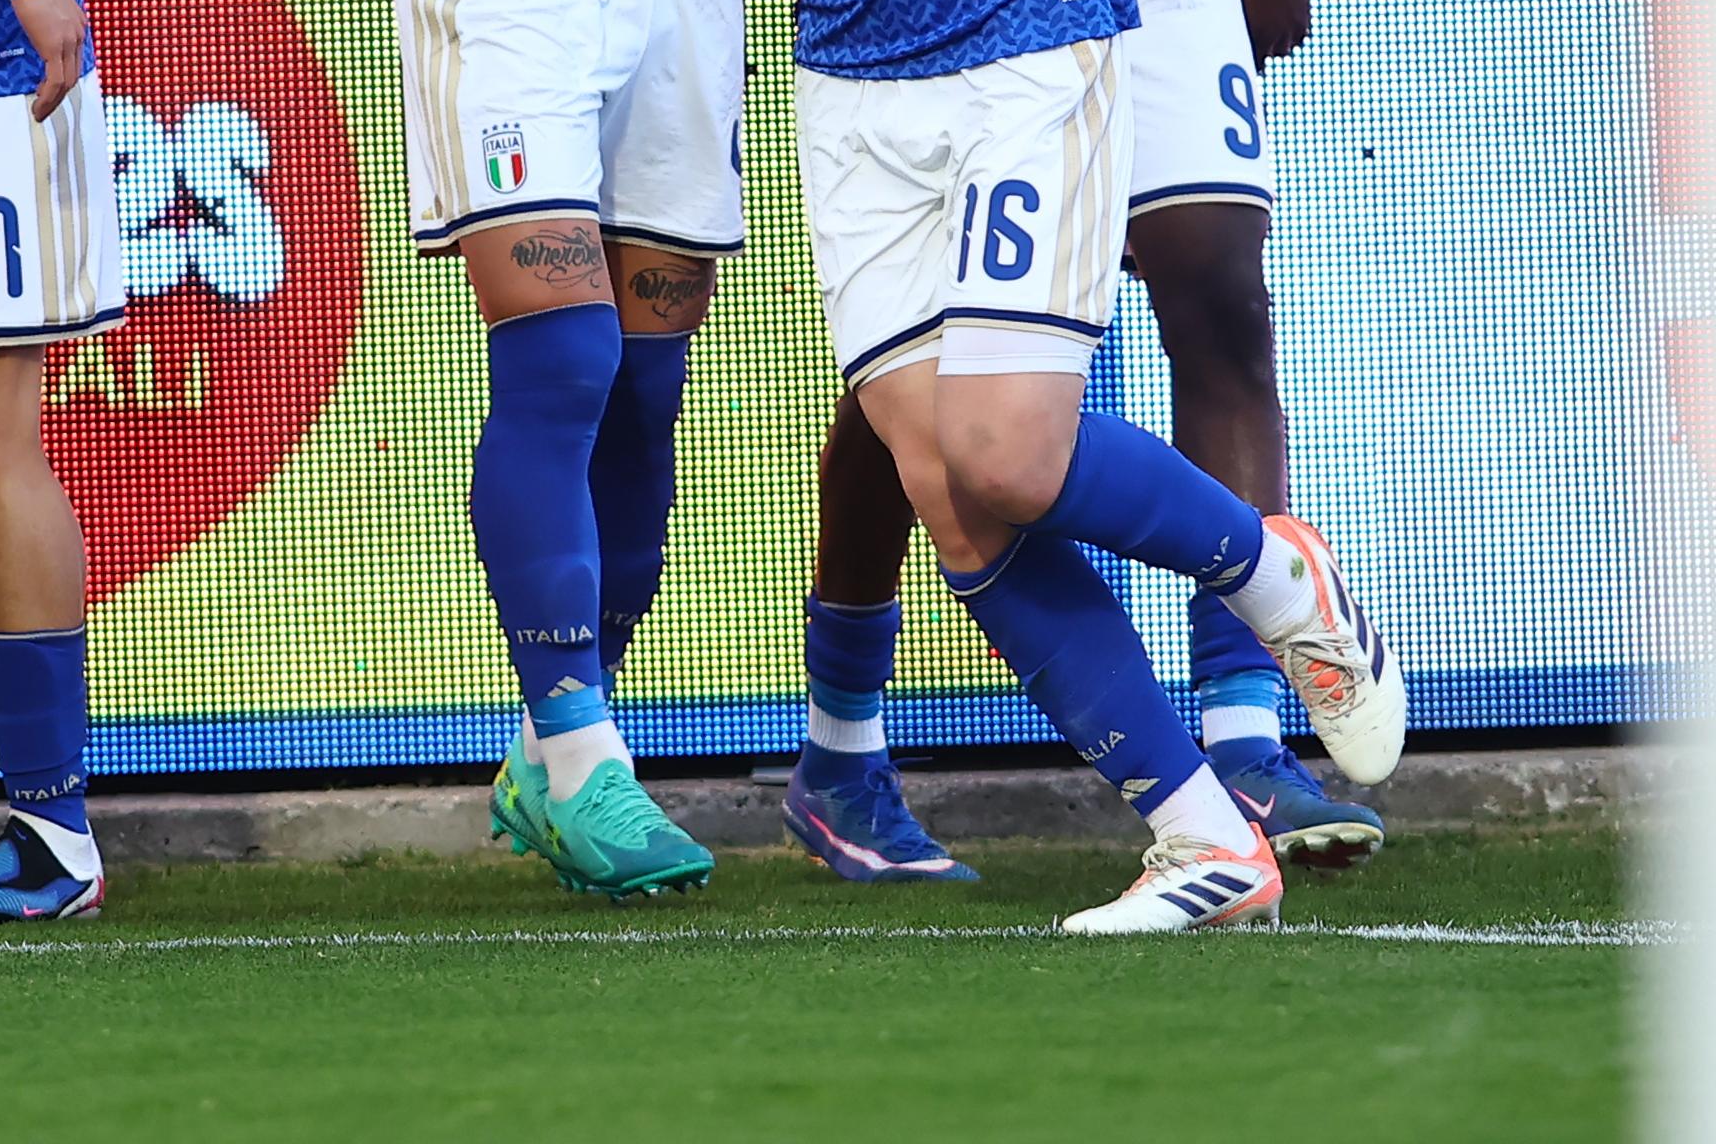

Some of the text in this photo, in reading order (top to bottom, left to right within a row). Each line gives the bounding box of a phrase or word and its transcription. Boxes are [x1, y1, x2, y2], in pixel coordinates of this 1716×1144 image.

[1218, 62, 1261, 159] 9
[485, 136, 520, 152] ITALIA
[957, 179, 1040, 283] 16
[516, 624, 594, 644] ITALIA
[15, 773, 81, 801] ITALIA
